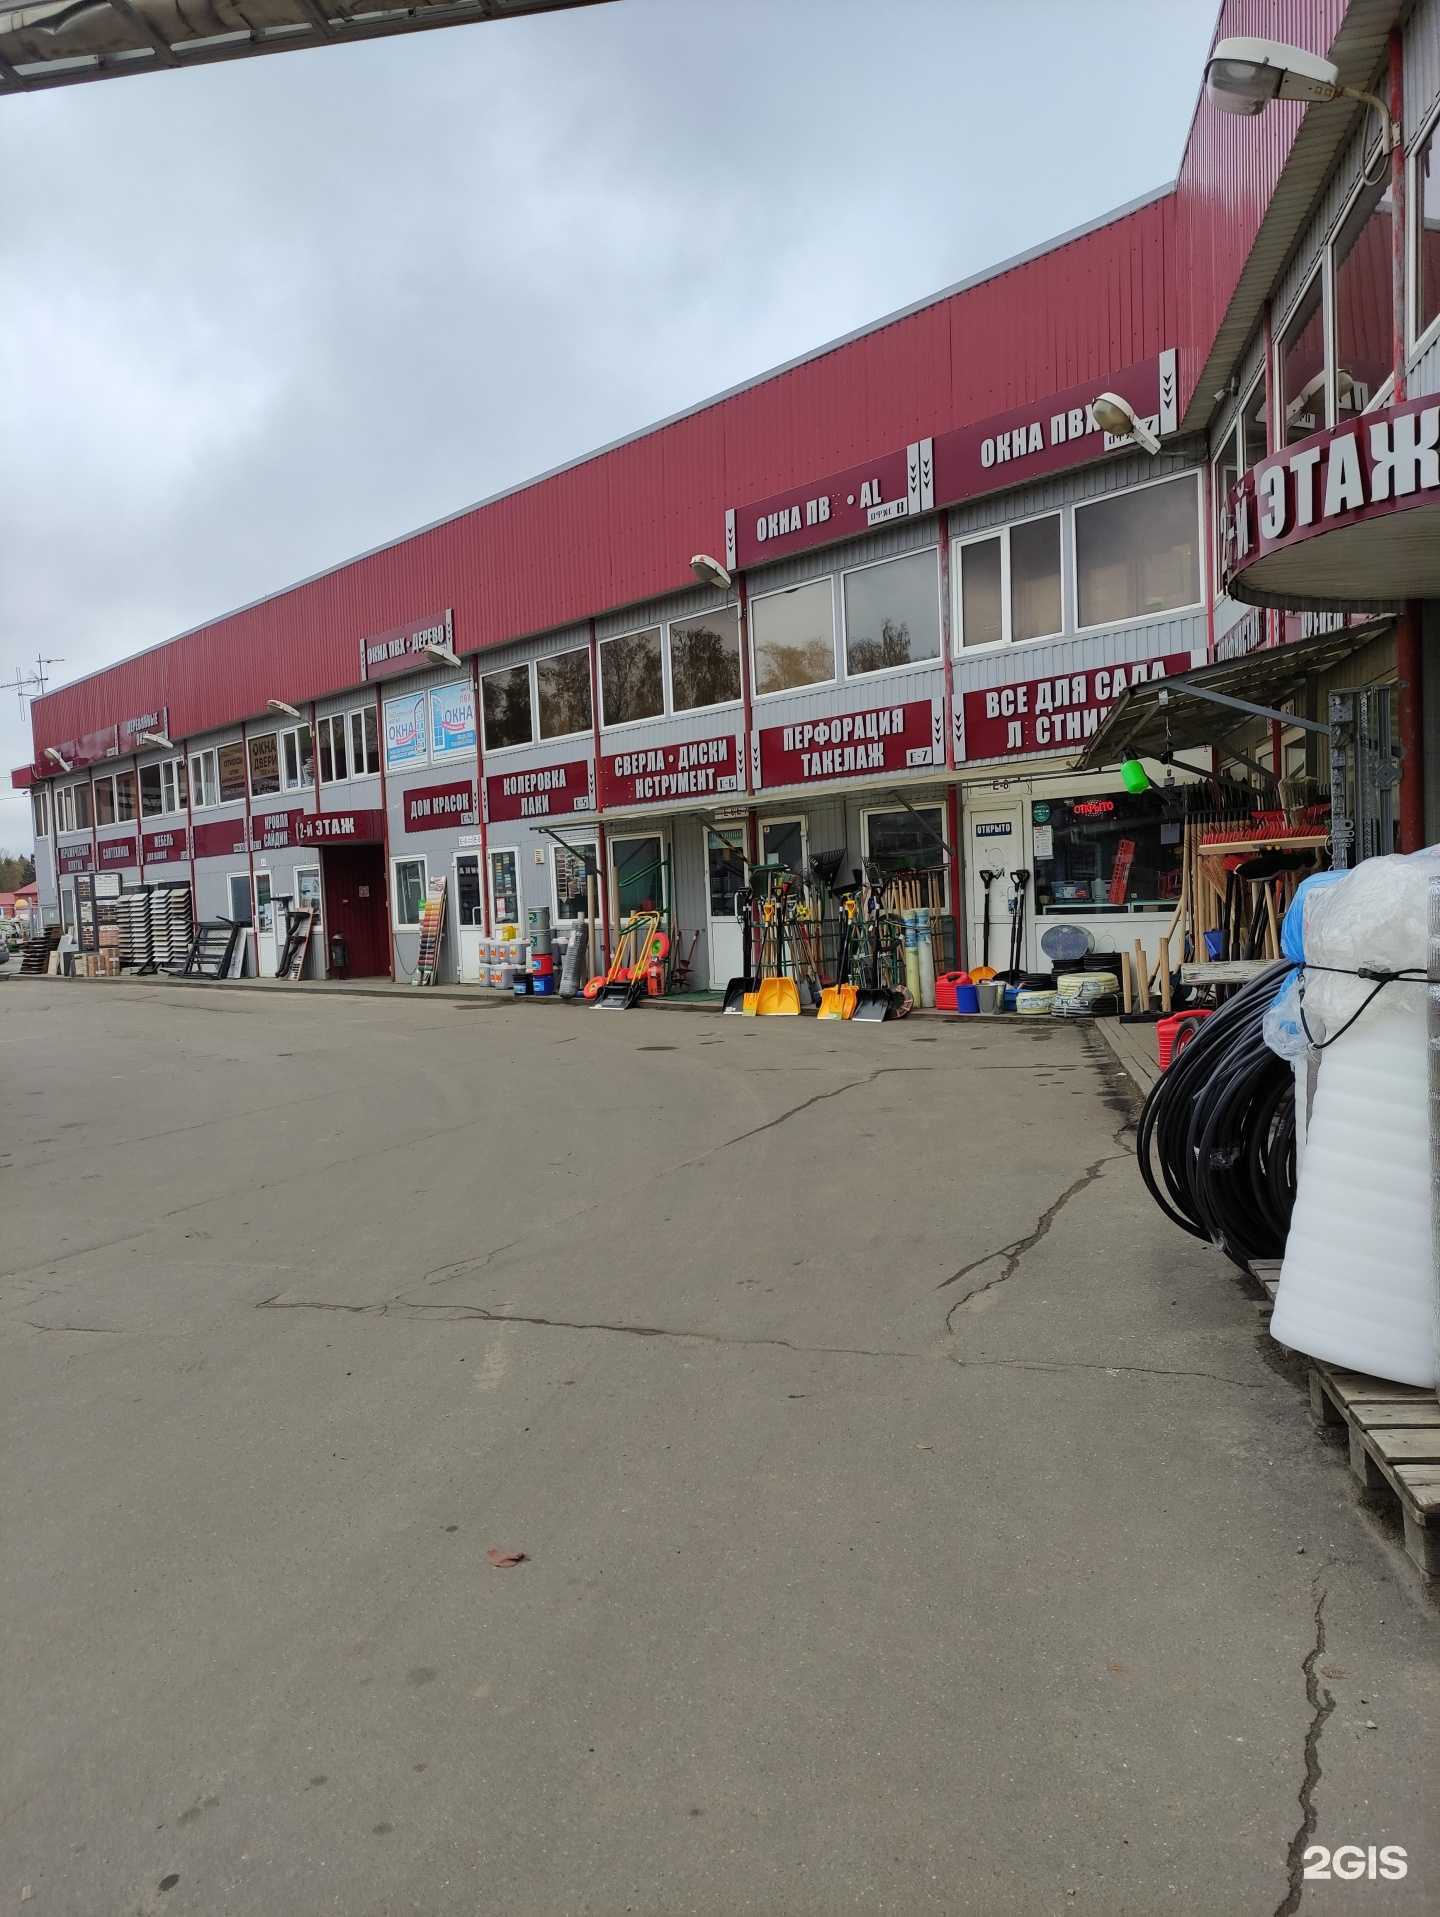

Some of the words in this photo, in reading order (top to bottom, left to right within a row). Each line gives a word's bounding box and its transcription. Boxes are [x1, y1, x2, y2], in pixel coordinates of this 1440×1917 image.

[981, 422, 1044, 468] ОКНА
[1259, 407, 1440, 540] ЭТАЖ
[757, 506, 802, 542] ОКНА
[367, 643, 389, 665] ОКНА
[388, 637, 406, 658] ПВХ
[411, 624, 444, 654] ДЕРЕВО
[986, 686, 1028, 719] ВСЕ
[1035, 675, 1087, 715] ДЛЯ
[445, 704, 473, 723] ОКНА
[389, 722, 414, 740] ОКНА
[783, 708, 904, 752] ПЕРФОРАЦИЯ
[252, 741, 277, 756] ОКНА
[615, 750, 665, 777] СВЕРЛА
[678, 739, 727, 771] ДИСКИ
[801, 742, 884, 777] ТАКЕЛАЖ
[503, 768, 566, 796] КОЛЕРОВКА
[635, 768, 715, 799] НСТРУМЕНТ
[410, 799, 430, 820] ДОМ
[433, 792, 469, 813] КРАСОК
[521, 795, 550, 816] ЛАКИ
[1073, 800, 1114, 815] ОТКРЫТО
[316, 817, 355, 836] ЭТАЖ
[977, 822, 1011, 836] ОТКРЫТО
